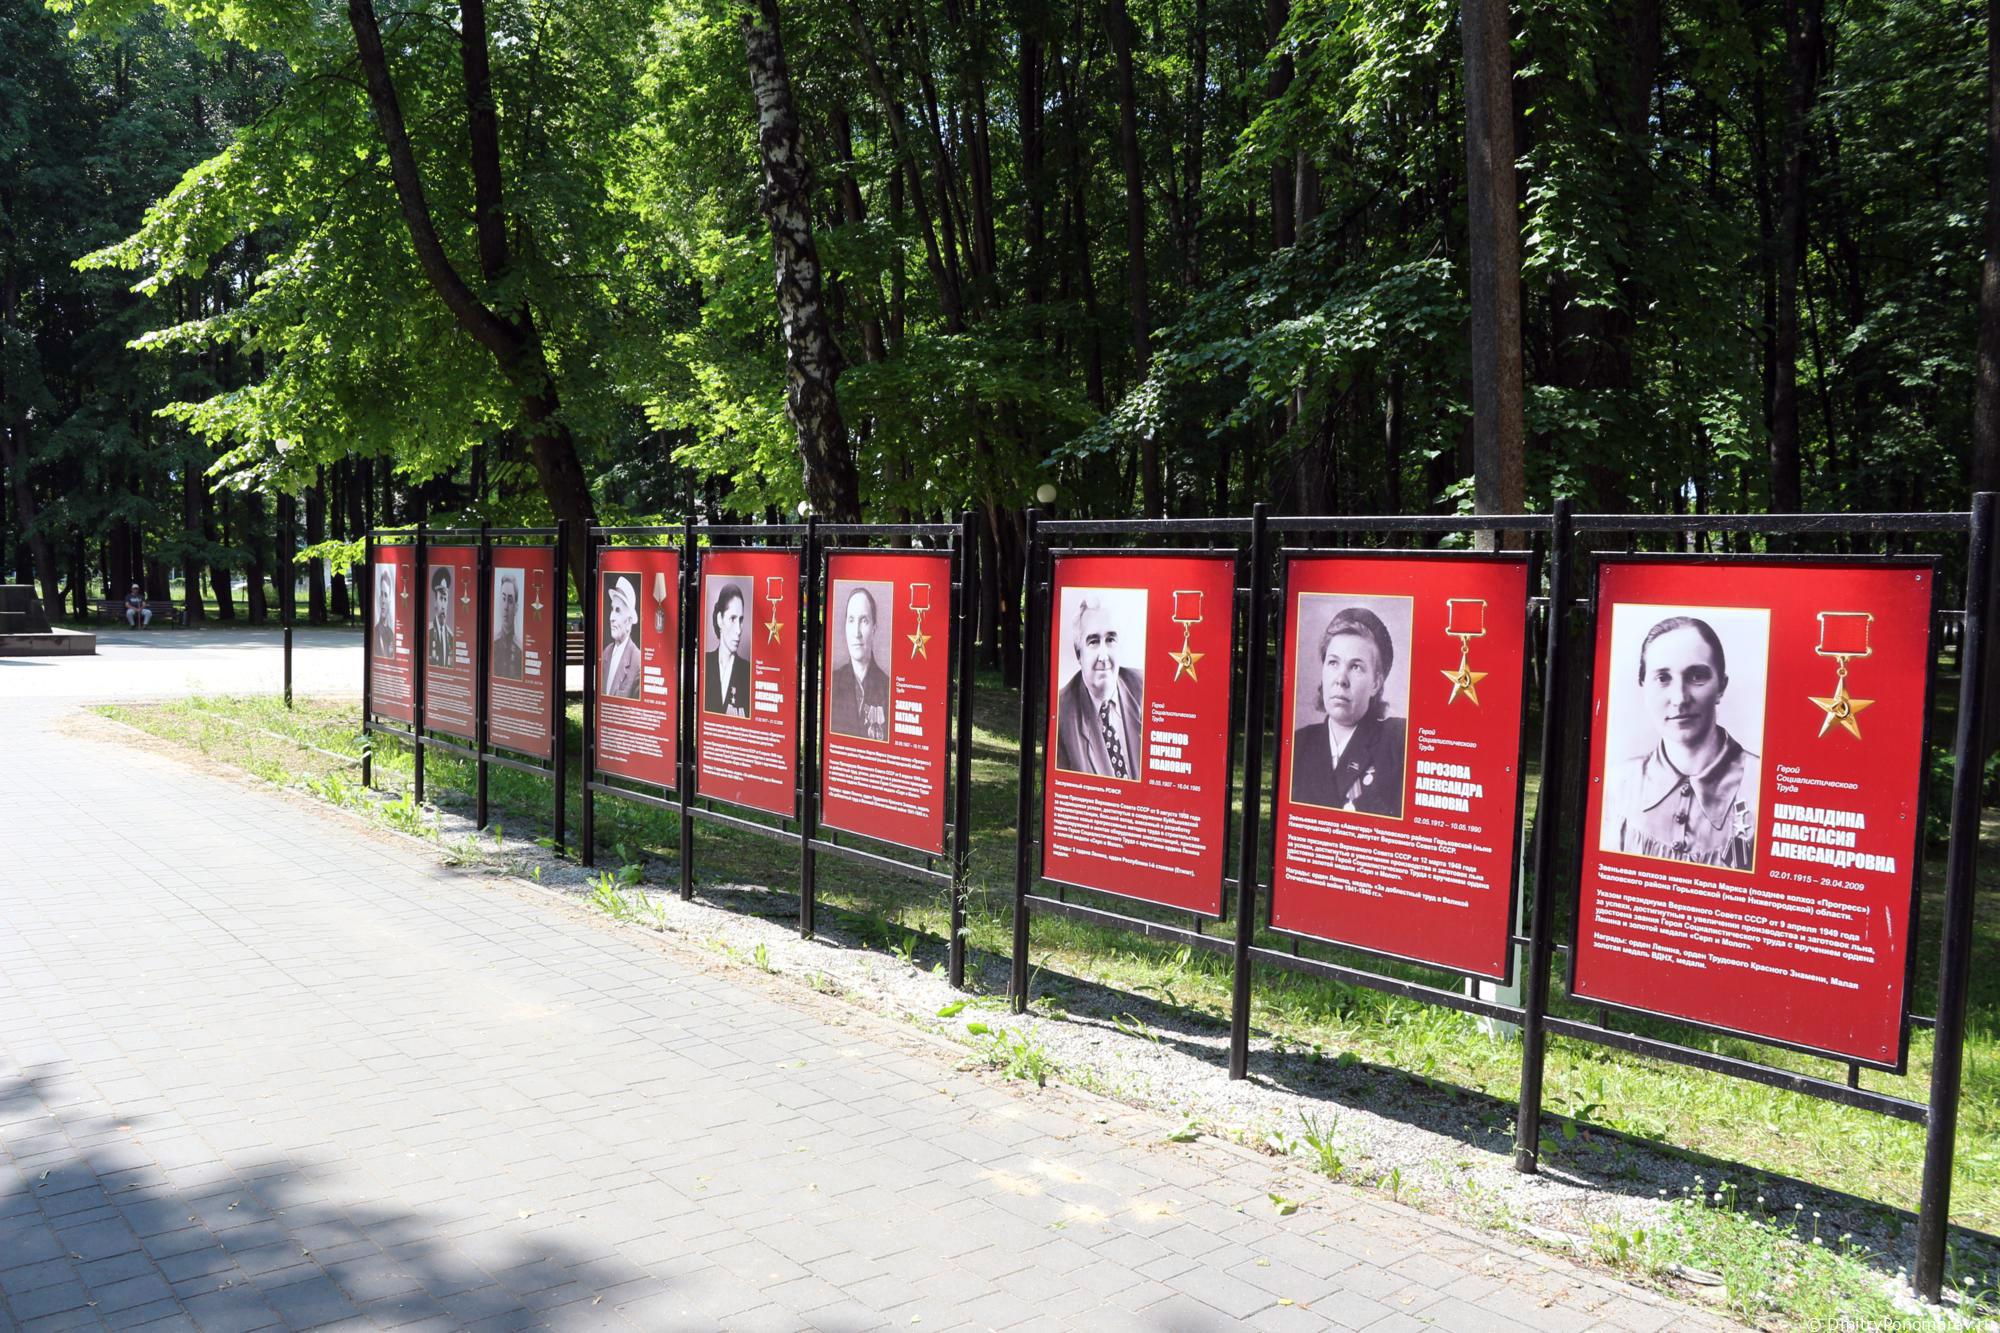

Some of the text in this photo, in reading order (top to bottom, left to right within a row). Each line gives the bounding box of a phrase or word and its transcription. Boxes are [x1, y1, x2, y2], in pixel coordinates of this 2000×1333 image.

[1151, 731, 1189, 745] СМИРНОВ
[1150, 744, 1181, 758] КИРИЛЛ
[1150, 758, 1191, 774] ИВАНОВИЧ
[1417, 761, 1471, 779] ПОРОЗОВА
[1777, 765, 1800, 775] Герой
[1416, 777, 1483, 799] АЛЕКСАНДРА
[1776, 774, 1858, 790] Социалистического
[1776, 784, 1799, 794] Труда
[1415, 793, 1469, 812] ИВАНОВНА
[1774, 804, 1865, 831] ШУВАЛДИНА
[1772, 822, 1856, 848] АНАСТАСИЯ
[1438, 845, 1456, 854] СССР.
[1771, 841, 1896, 875] АЛЕКСАНДРОВНА
[1599, 864, 1870, 915] Звеньевая колхоза имени Карла Маркса (позднее колхоз «Прогресс»)
[1770, 870, 1812, 883] 02.01.1915
[1820, 878, 1864, 891] 29.04.2009
[1598, 873, 1853, 920] Чкаловского района Горьковской (ныне Нижегородской) области.
[1597, 890, 1622, 899] Указом
[1623, 895, 1667, 909] президиума
[1668, 902, 1713, 916] Верховного
[1714, 909, 1743, 920] Совета
[1744, 914, 1768, 925] СССР
[1787, 924, 1817, 935] апреля
[1819, 928, 1838, 937] 1949
[1840, 933, 1860, 942] года
[1605, 901, 1632, 911] успехи,
[1693, 916, 1740, 931] увеличении
[1741, 925, 1798, 941] производства
[1808, 937, 1849, 949] заготовок
[1851, 944, 1875, 954] льна,
[1595, 915, 1621, 925] Ленина
[1629, 921, 1658, 932] золотой
[1659, 928, 1688, 939] медали
[1689, 932, 1713, 944] «Серп
[1722, 938, 1753, 950] Молот».
[1596, 908, 1632, 920] удостоена
[1634, 915, 1659, 924] звания
[1661, 917, 1683, 929] Героя
[1684, 922, 1761, 943] Социалистического
[1762, 938, 1786, 948] труда
[1794, 944, 1841, 958] вручением
[1842, 952, 1874, 964] ордена
[1594, 942, 1706, 969] золотая медаль ВДНХ, медали.
[1594, 932, 1859, 989] Награды: орден Ленина, орден Трудового Красного Знамени, Малая
